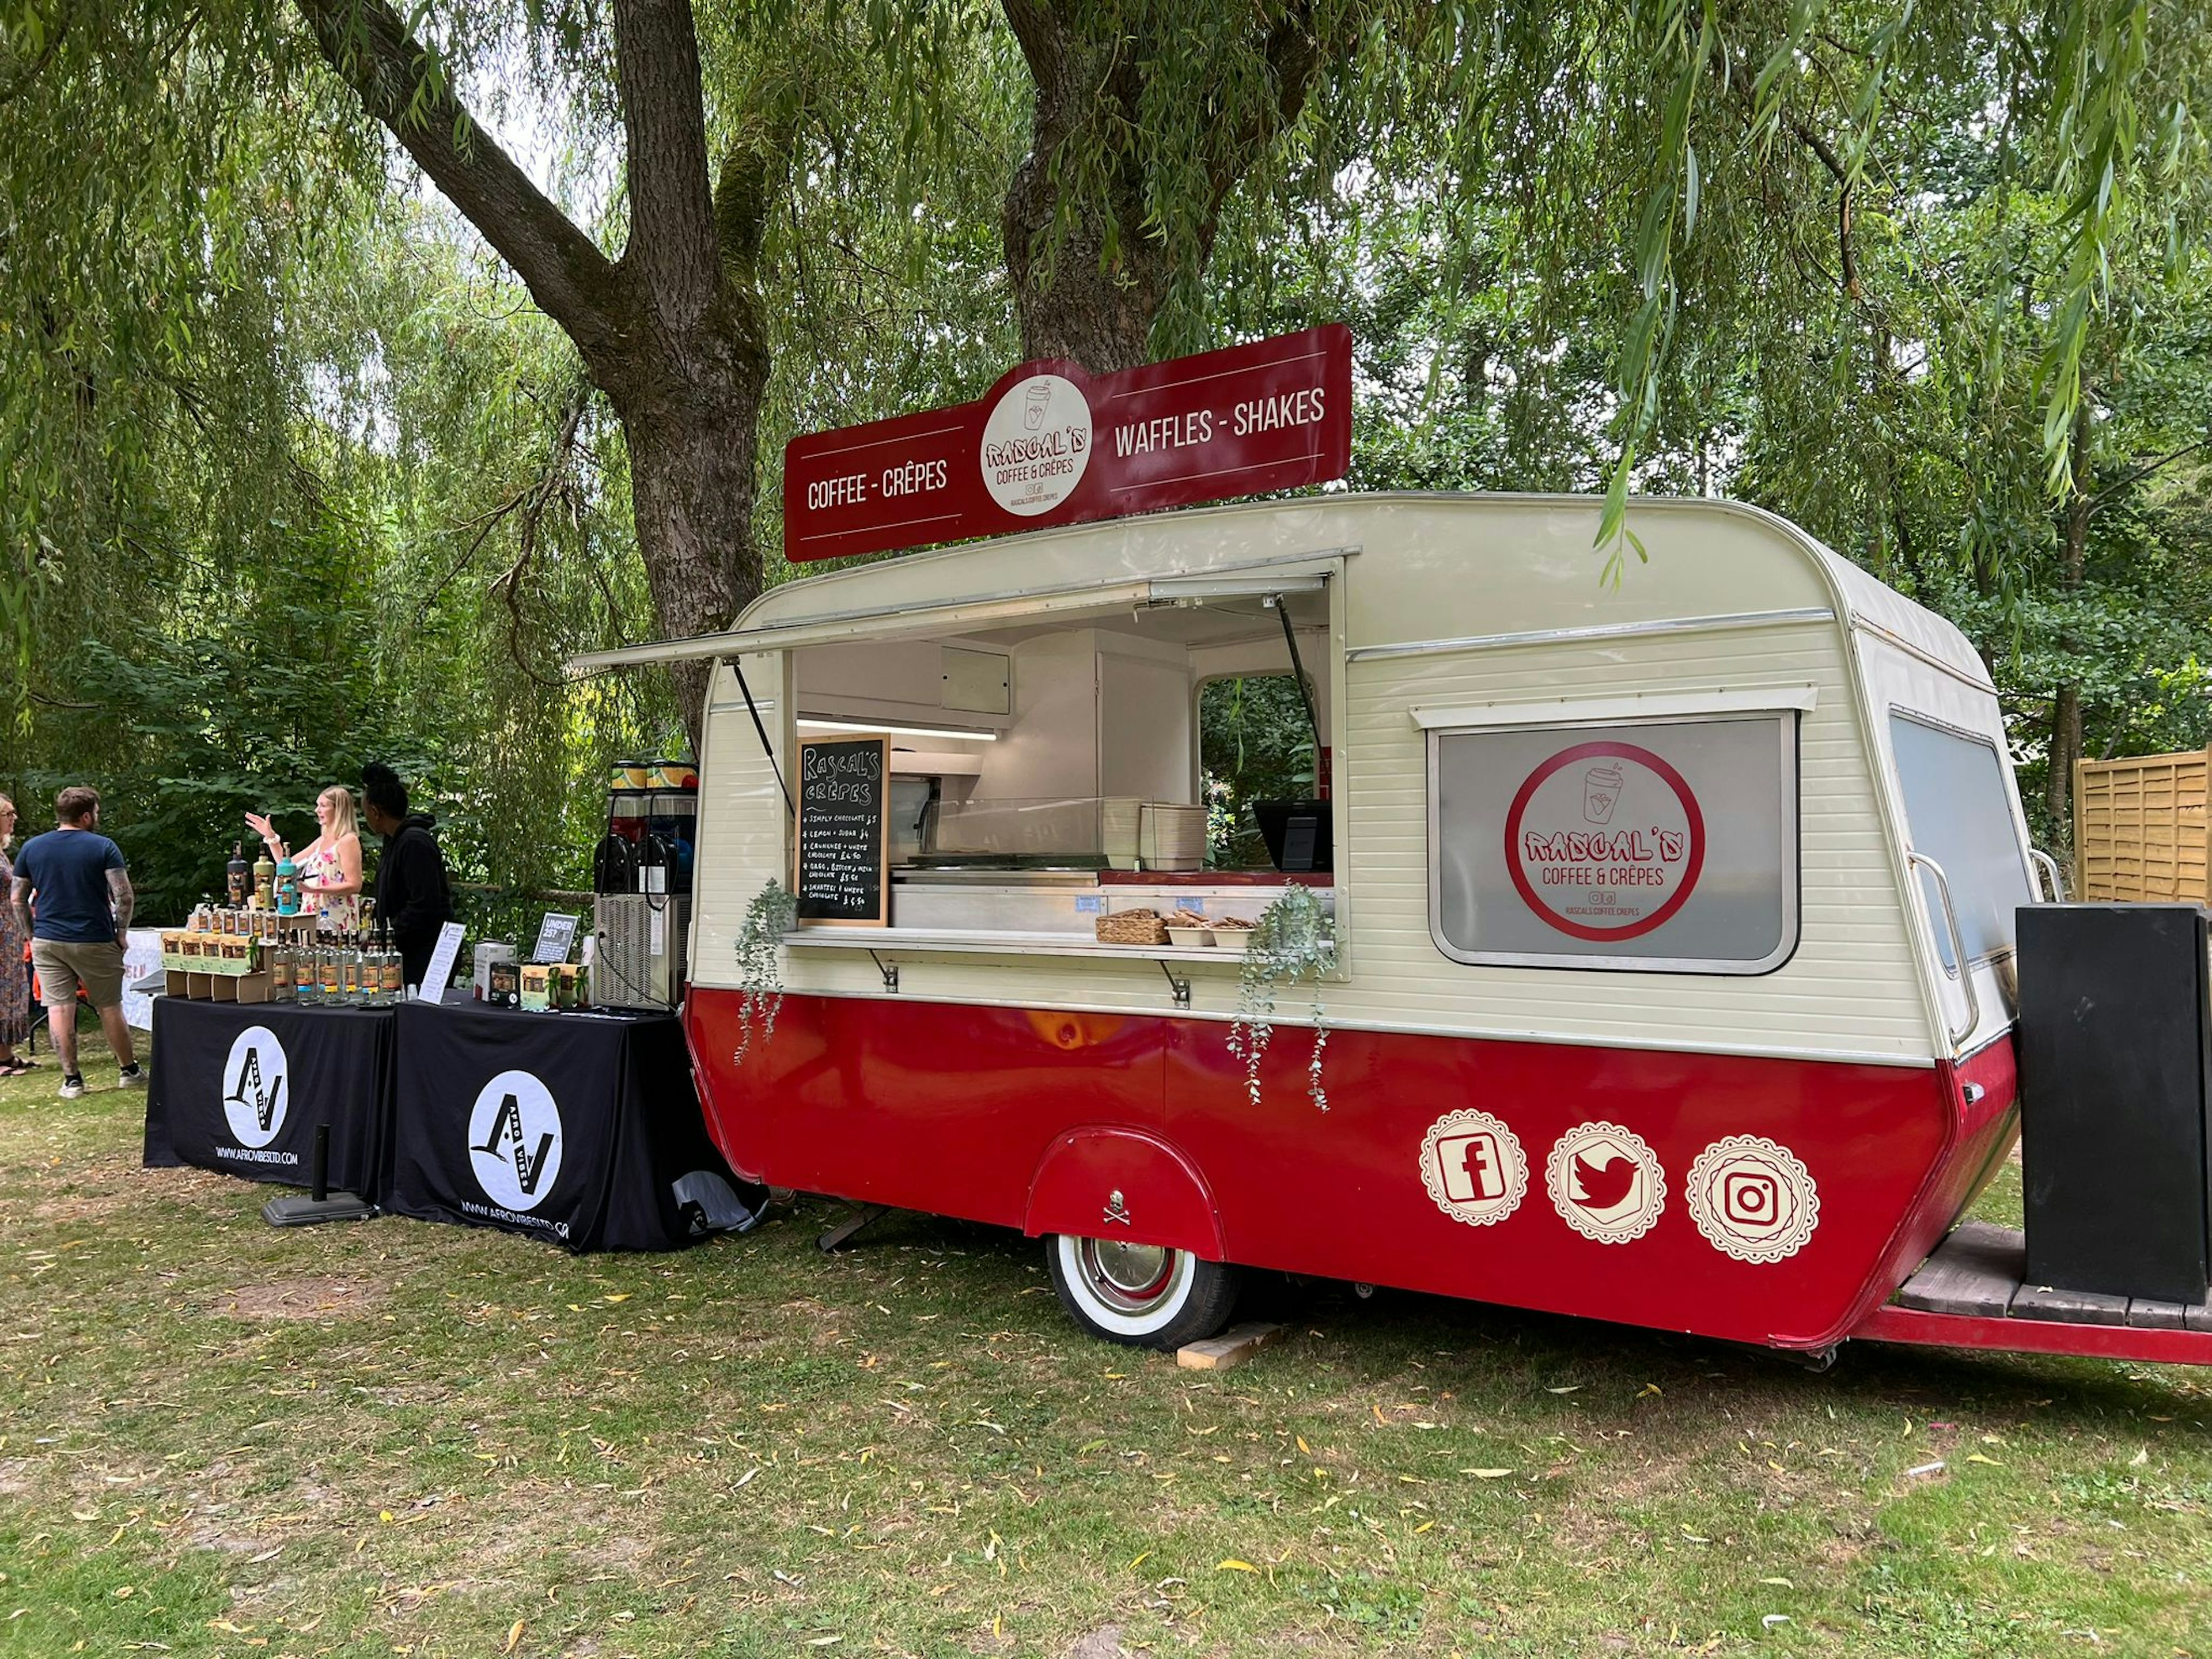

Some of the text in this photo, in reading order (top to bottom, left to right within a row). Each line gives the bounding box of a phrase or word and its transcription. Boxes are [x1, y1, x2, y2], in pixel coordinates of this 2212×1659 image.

[1115, 410, 1213, 457] WAFFLES
[1234, 387, 1325, 436] SHAKES
[986, 426, 1086, 468] RASCAL'S
[808, 474, 866, 510] COFFEE
[882, 460, 947, 497] CRÊPES
[997, 465, 1028, 484] COFFEE
[1031, 465, 1037, 479] &
[804, 748, 880, 782] RASCAL'S
[809, 815, 832, 823] SIMPLY
[809, 830, 831, 838] LEMON
[1525, 826, 1683, 862] RASCAL'S
[1543, 865, 1664, 885] COFFEE & CRÊPES
[543, 928, 558, 938] 25?
[546, 919, 573, 931] UNDER
[509, 1106, 520, 1138] AFRO
[517, 1150, 529, 1187] VIBES
